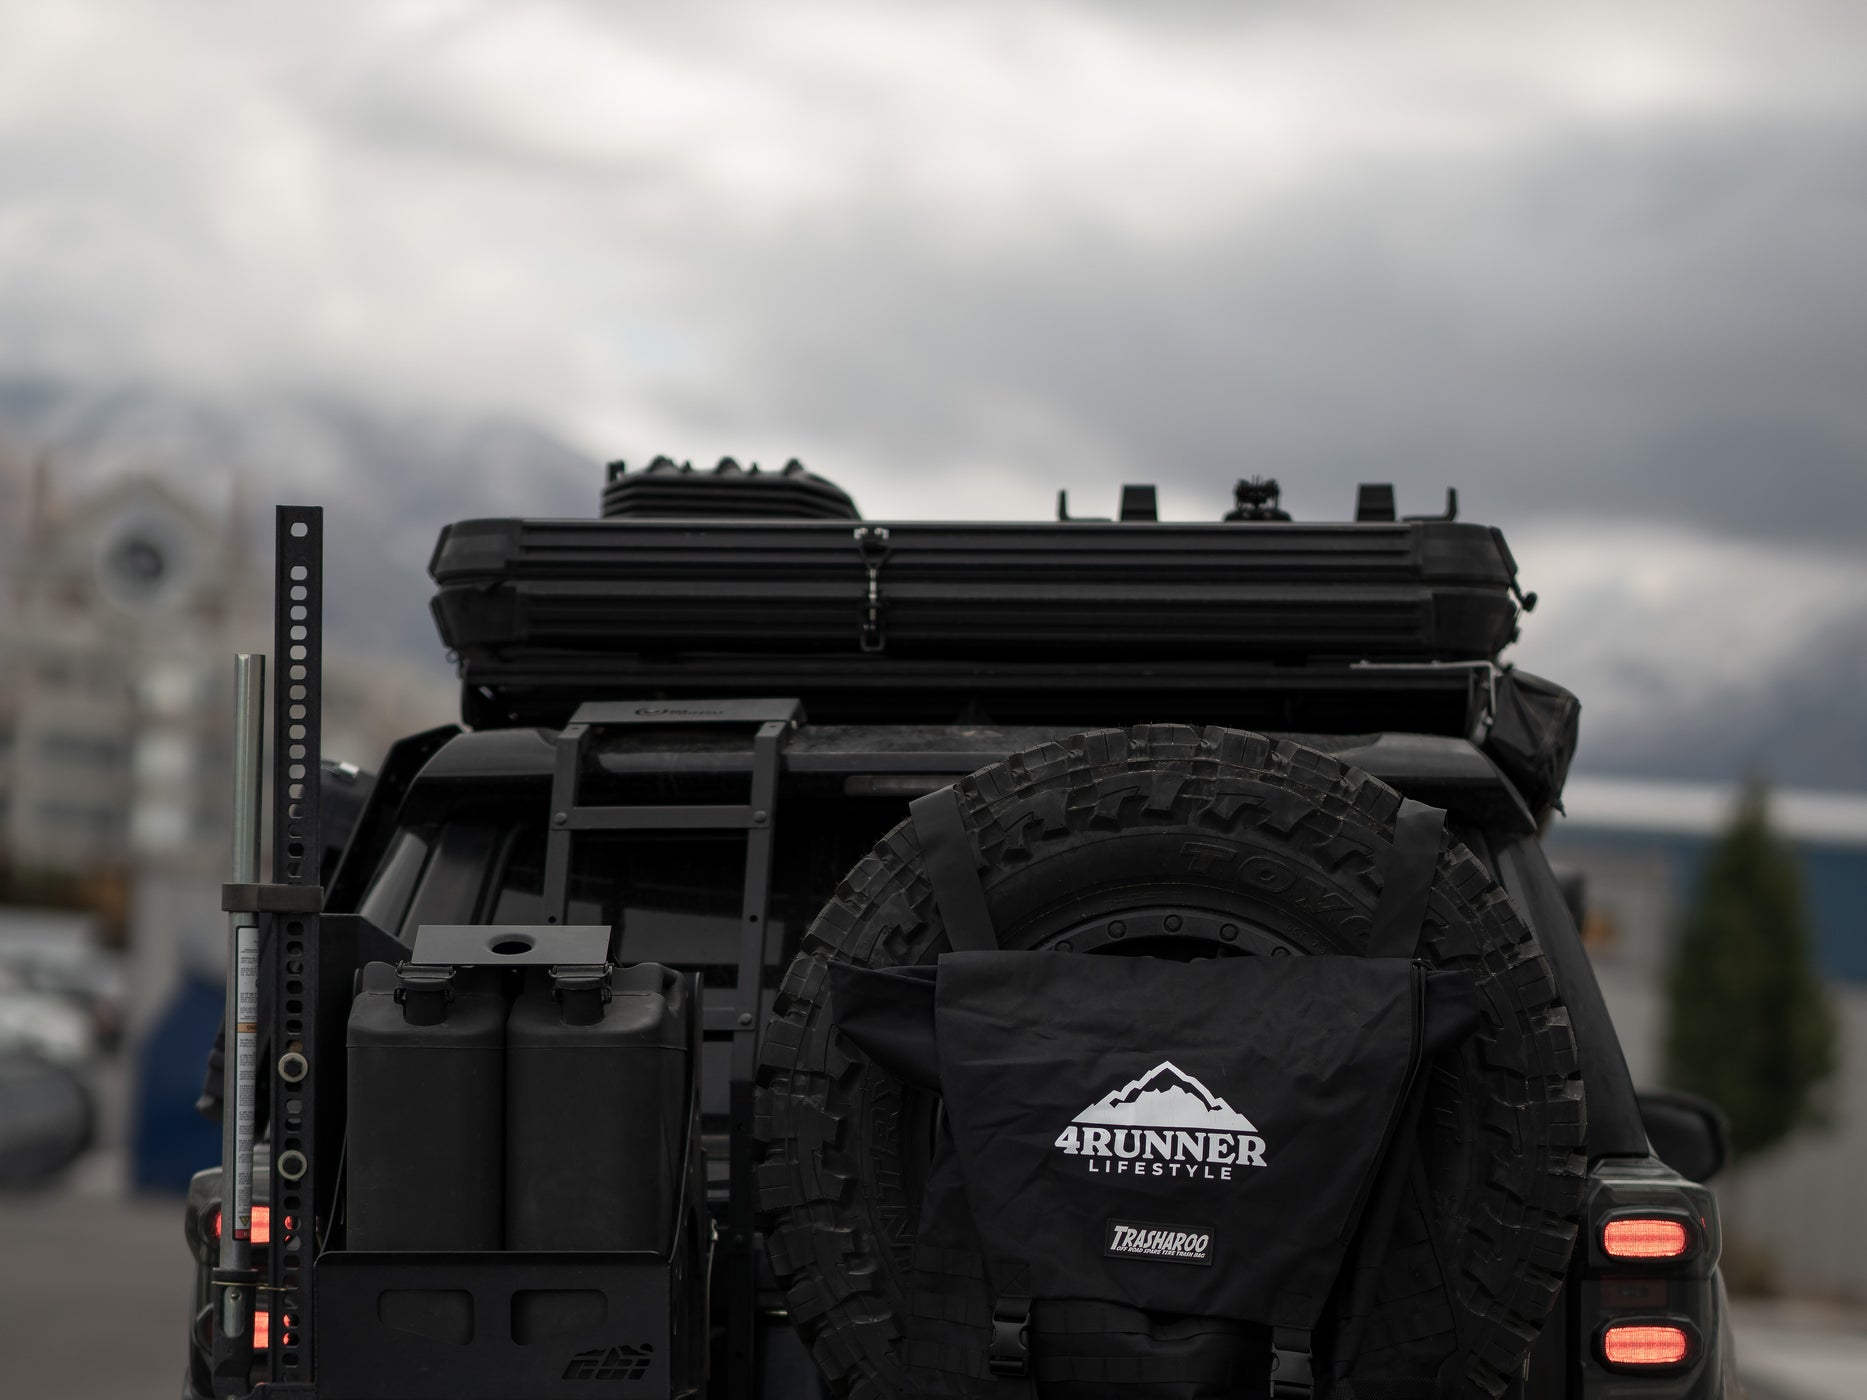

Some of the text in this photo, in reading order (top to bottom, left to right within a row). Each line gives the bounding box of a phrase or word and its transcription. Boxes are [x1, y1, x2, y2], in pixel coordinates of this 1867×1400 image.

[1054, 1125, 1268, 1167] 4RUNNER
[1088, 1159, 1232, 1180] LIFESTYLE
[1110, 1225, 1209, 1252] TRASHAROO
